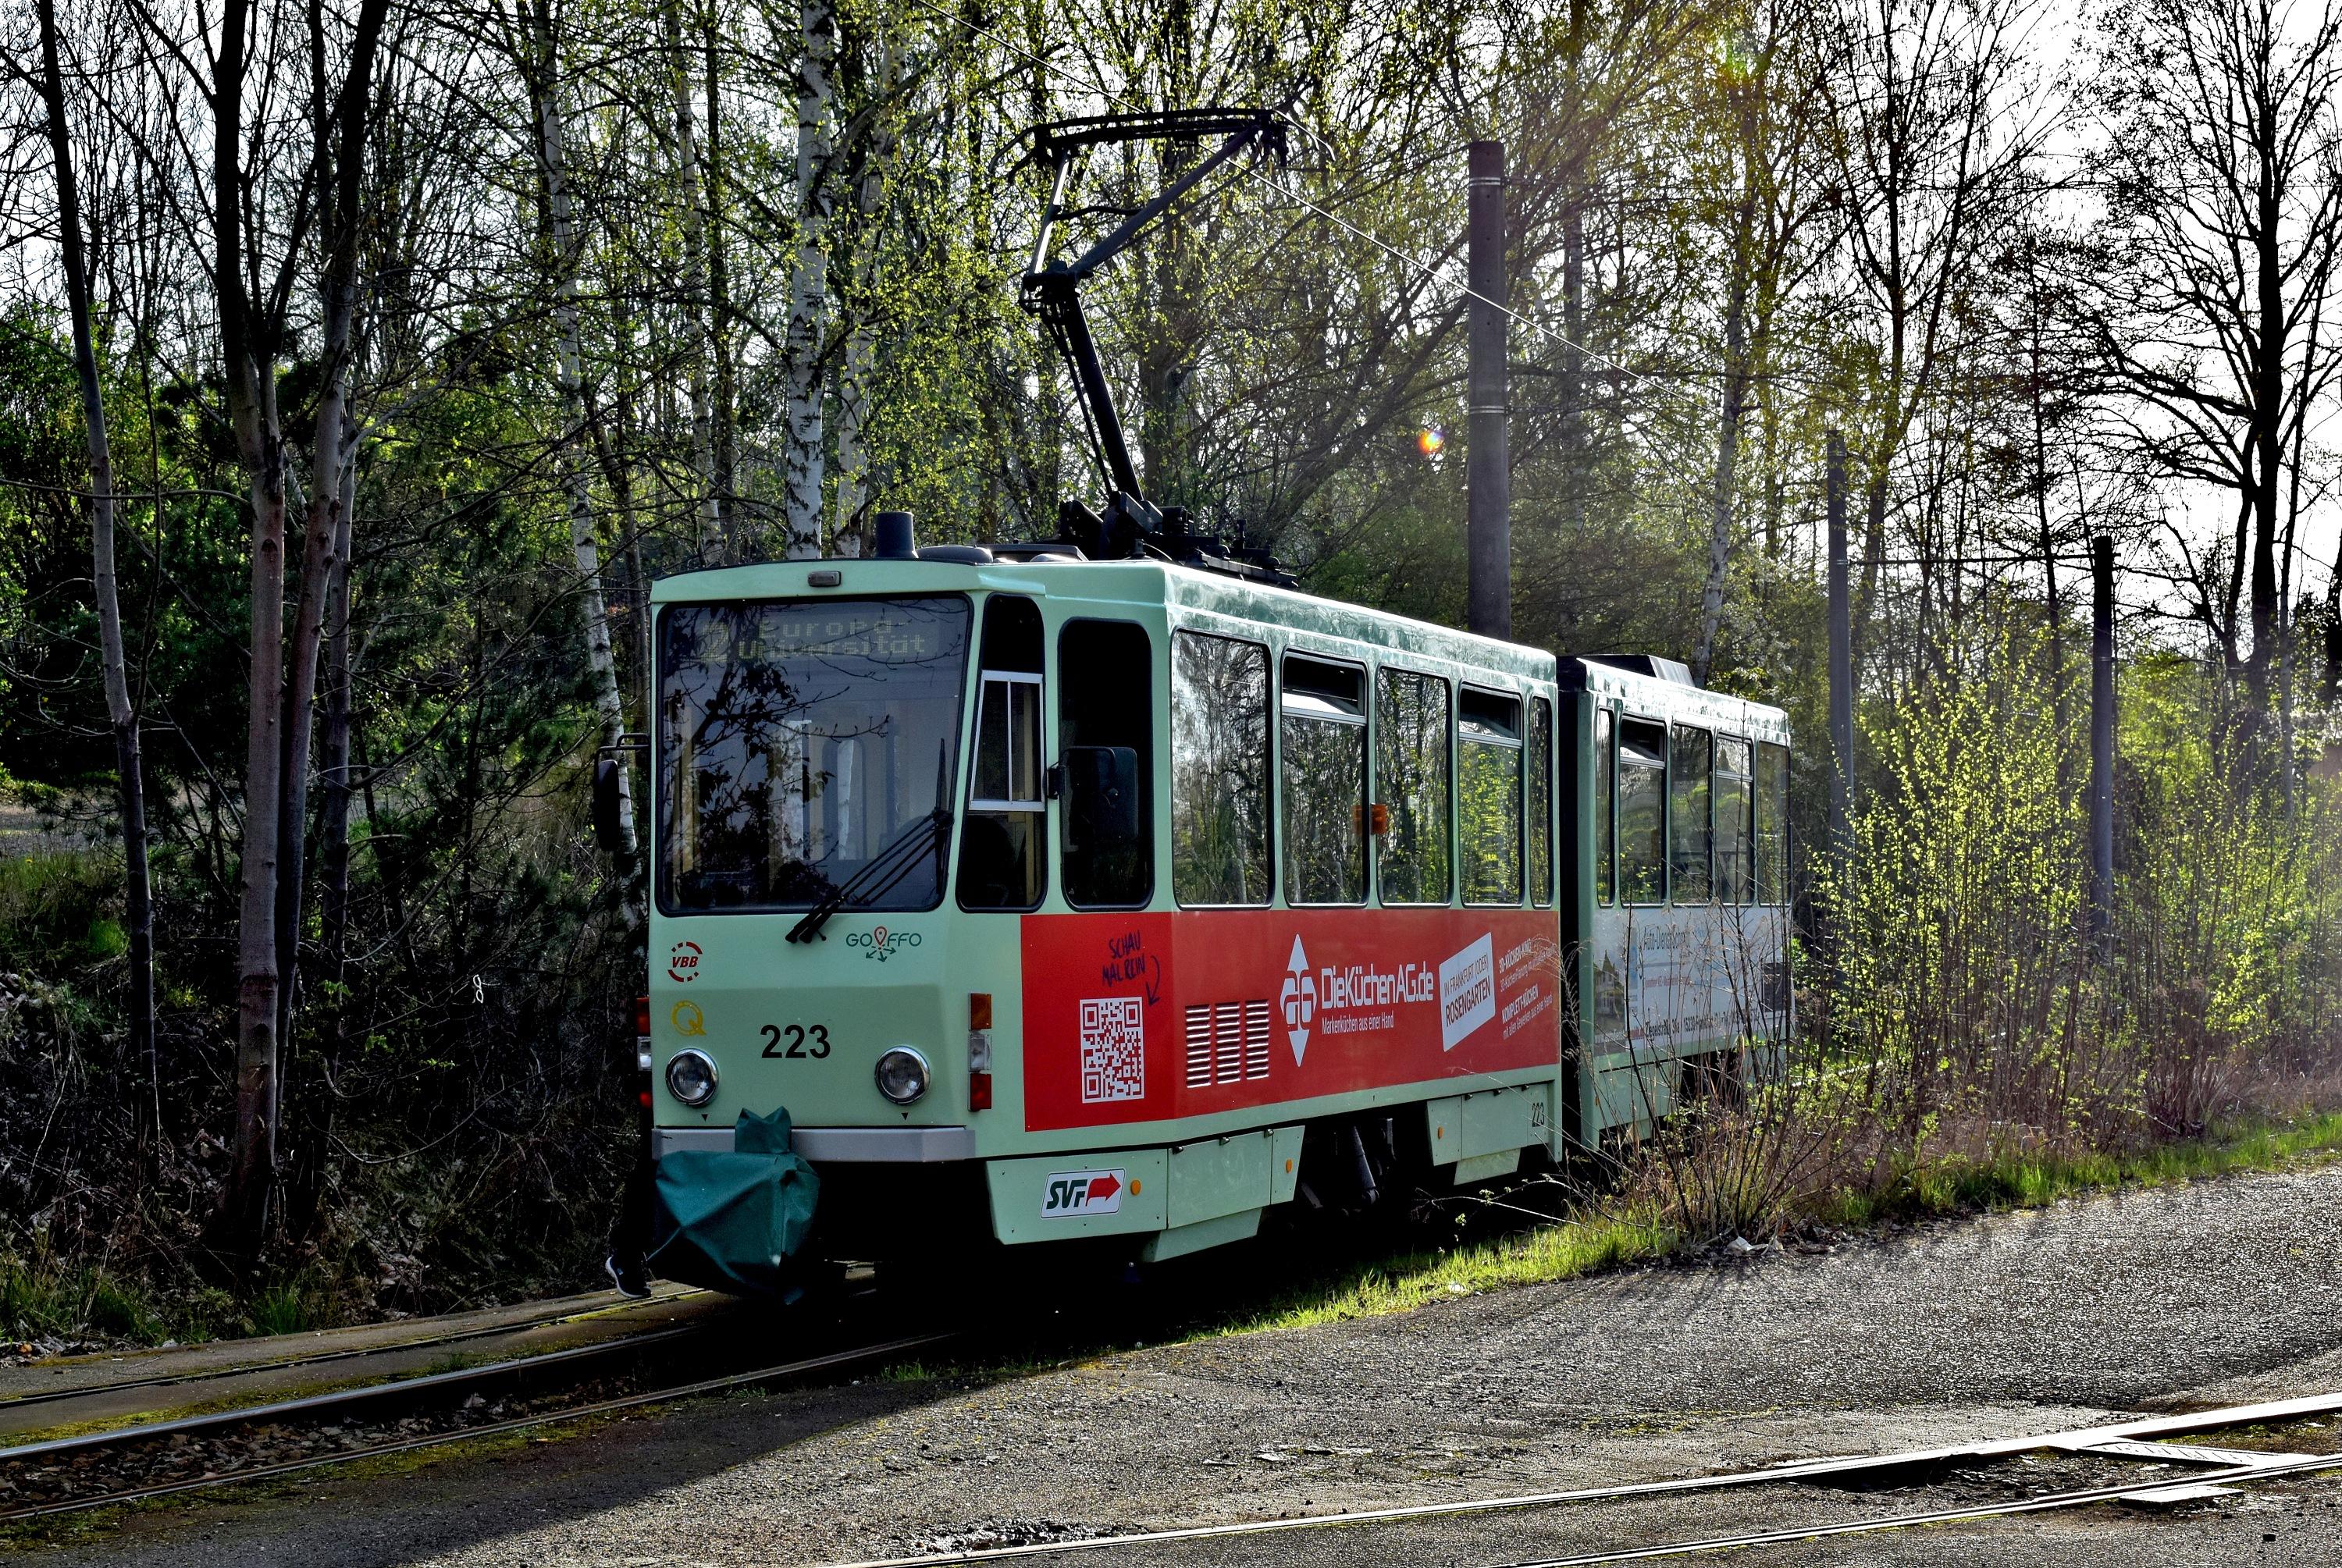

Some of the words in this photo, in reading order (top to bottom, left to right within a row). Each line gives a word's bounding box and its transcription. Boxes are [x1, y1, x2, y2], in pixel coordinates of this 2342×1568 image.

[702, 621, 729, 663] 2
[1109, 930, 1141, 959] SCHAU
[671, 955, 699, 969] VBB
[1102, 962, 1123, 987] MAL
[1124, 953, 1146, 980] REIN
[1321, 961, 1434, 1010] DieKüchenAG.de
[1443, 981, 1450, 997] IN
[1450, 963, 1474, 991] FRANKFURT
[1445, 975, 1491, 1027] ROSENGARTEN
[1322, 1014, 1358, 1036] Markenküchen
[1358, 1017, 1368, 1031] aus
[1369, 1012, 1381, 1030] einer
[1381, 1010, 1394, 1029] Hand
[760, 1024, 831, 1059] 223
[1532, 1101, 1545, 1128] 223
[1046, 1179, 1088, 1210] SVF
